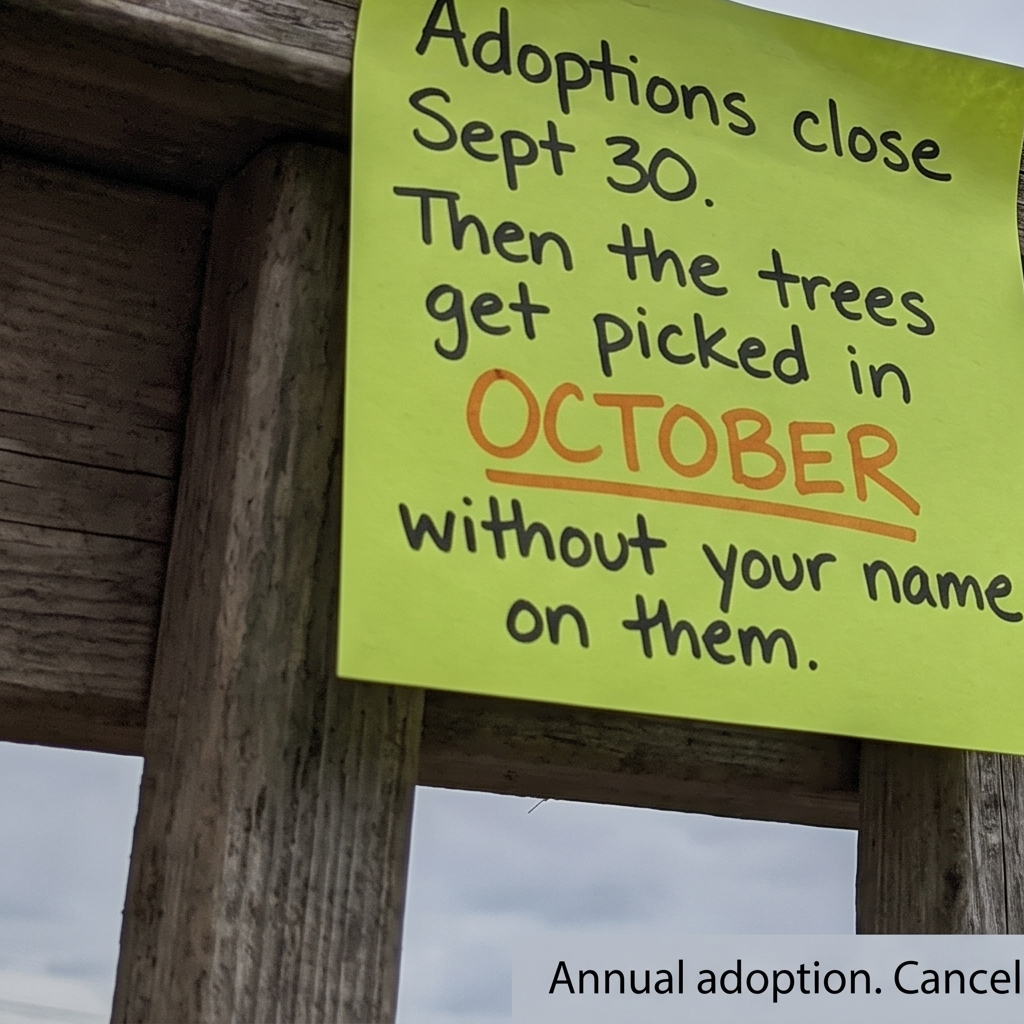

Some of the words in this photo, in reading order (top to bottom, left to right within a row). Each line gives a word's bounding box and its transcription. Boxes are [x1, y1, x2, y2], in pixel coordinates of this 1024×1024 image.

[408, 87, 576, 191] Sept
[605, 135, 716, 208] 30.
[792, 98, 952, 182] close
[392, 186, 574, 272] Then
[606, 223, 728, 297] the
[757, 248, 935, 336] trees
[425, 280, 551, 361] get
[592, 307, 810, 385] picked
[849, 345, 911, 405] in
[466, 368, 921, 516] OCTOBER
[398, 495, 667, 576] without
[702, 543, 837, 614] your
[862, 559, 1024, 623] name
[506, 599, 590, 649] on
[622, 594, 820, 672] them.
